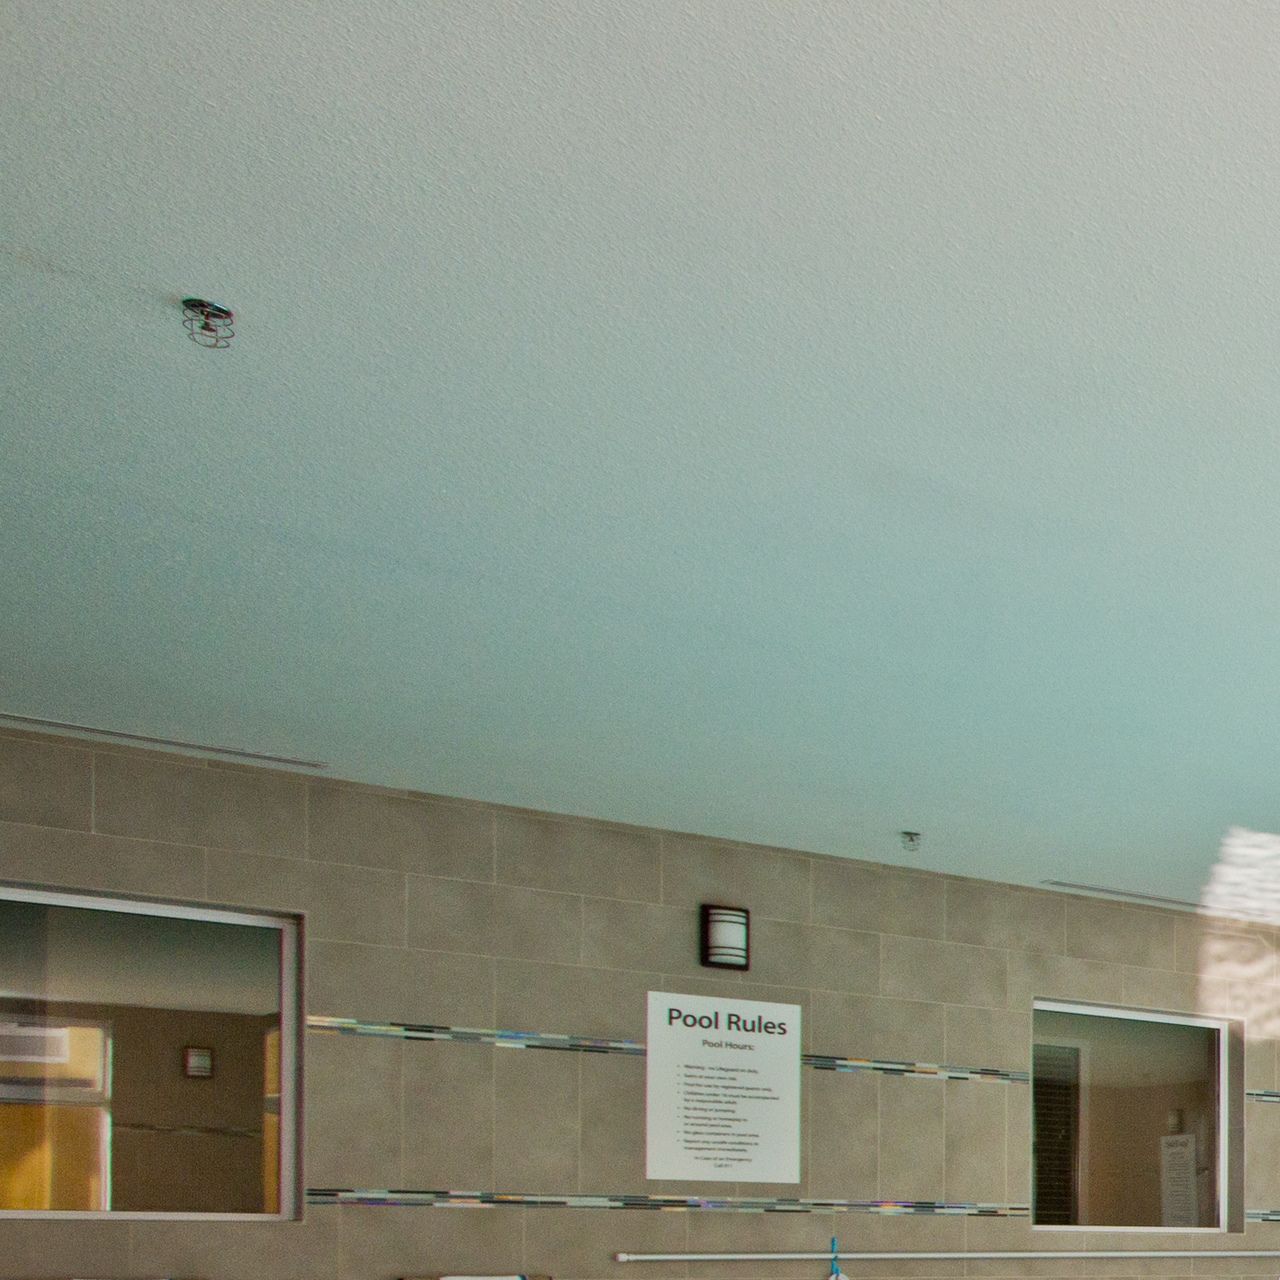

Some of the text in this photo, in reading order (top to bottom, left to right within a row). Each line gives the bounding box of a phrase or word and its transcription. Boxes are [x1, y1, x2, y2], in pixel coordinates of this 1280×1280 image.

[668, 1008, 787, 1035] Pool Rules
[702, 1039, 723, 1049] Pool
